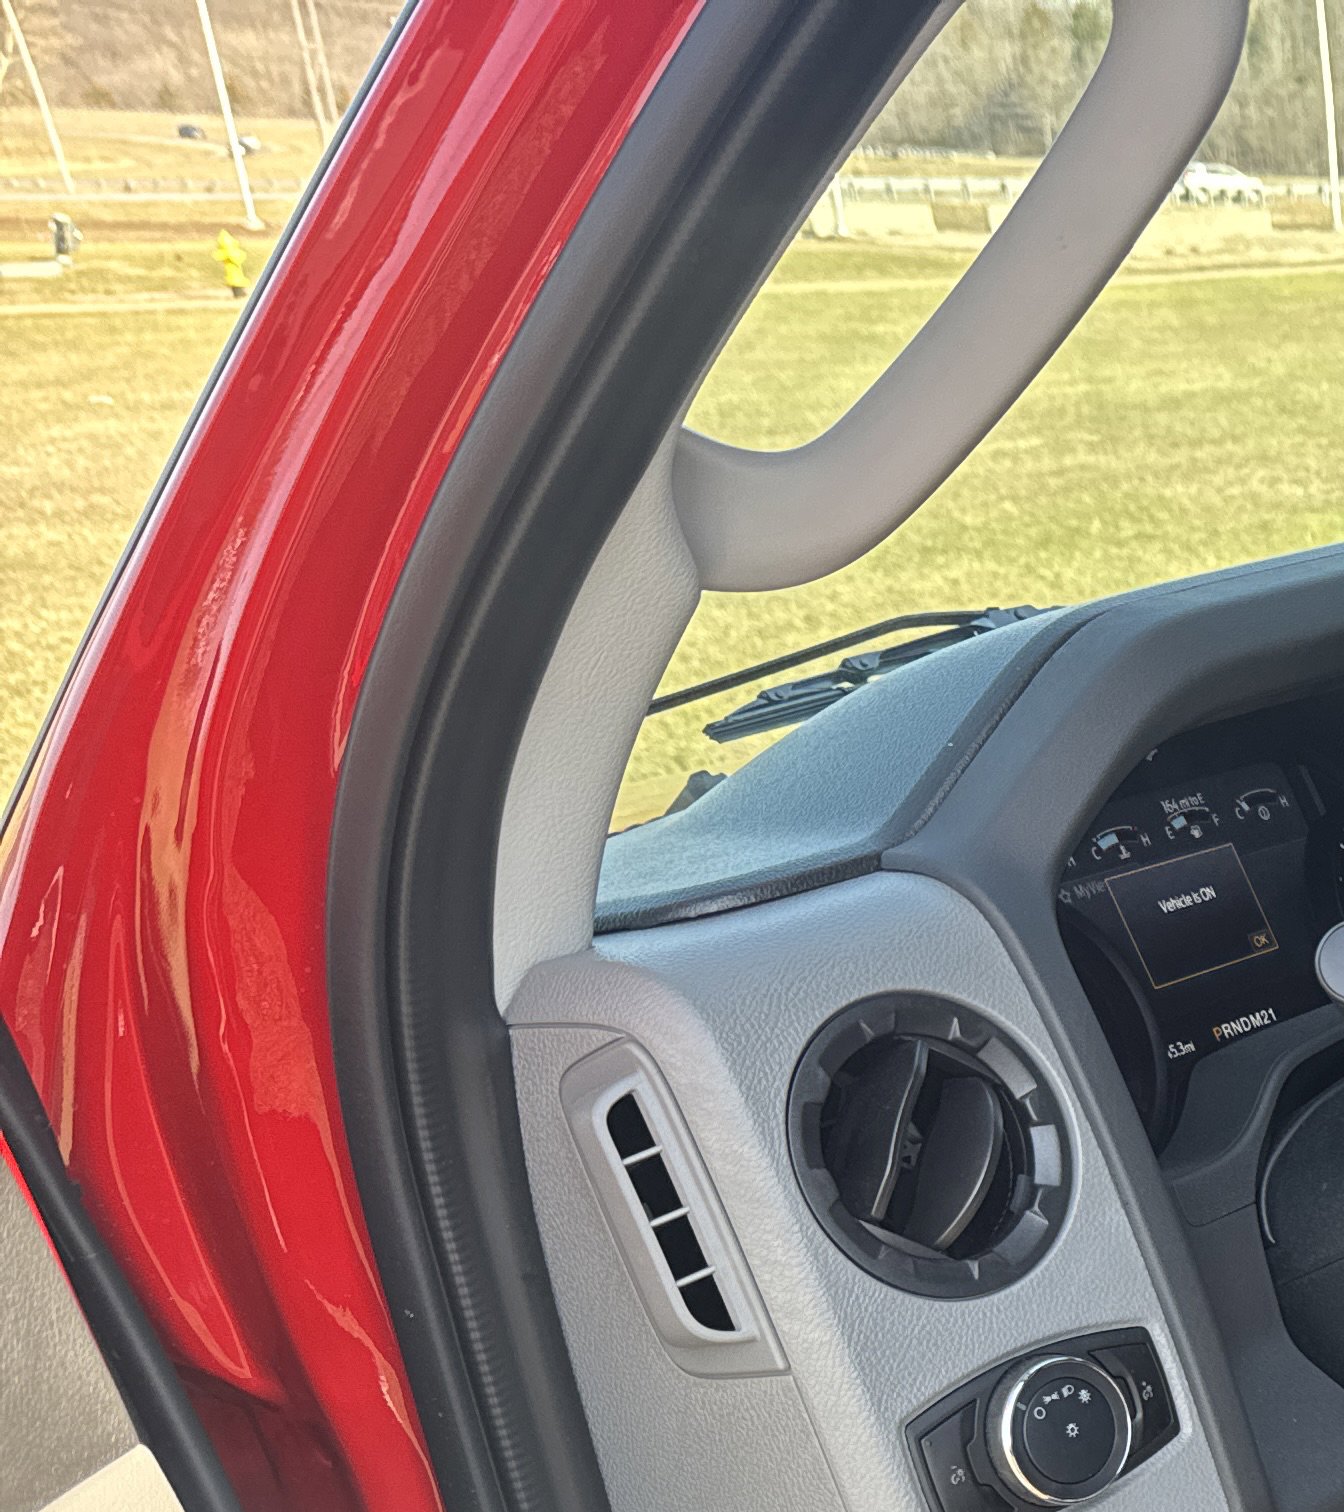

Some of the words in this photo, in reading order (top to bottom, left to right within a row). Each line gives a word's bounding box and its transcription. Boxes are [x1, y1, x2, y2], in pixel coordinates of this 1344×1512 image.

[1211, 813, 1222, 827] F
[1139, 833, 1152, 847] H
[1165, 826, 1175, 840] E
[1091, 846, 1102, 860] C
[1157, 893, 1193, 914] Vehicle
[1200, 885, 1217, 901] ON
[1253, 933, 1270, 948] OK
